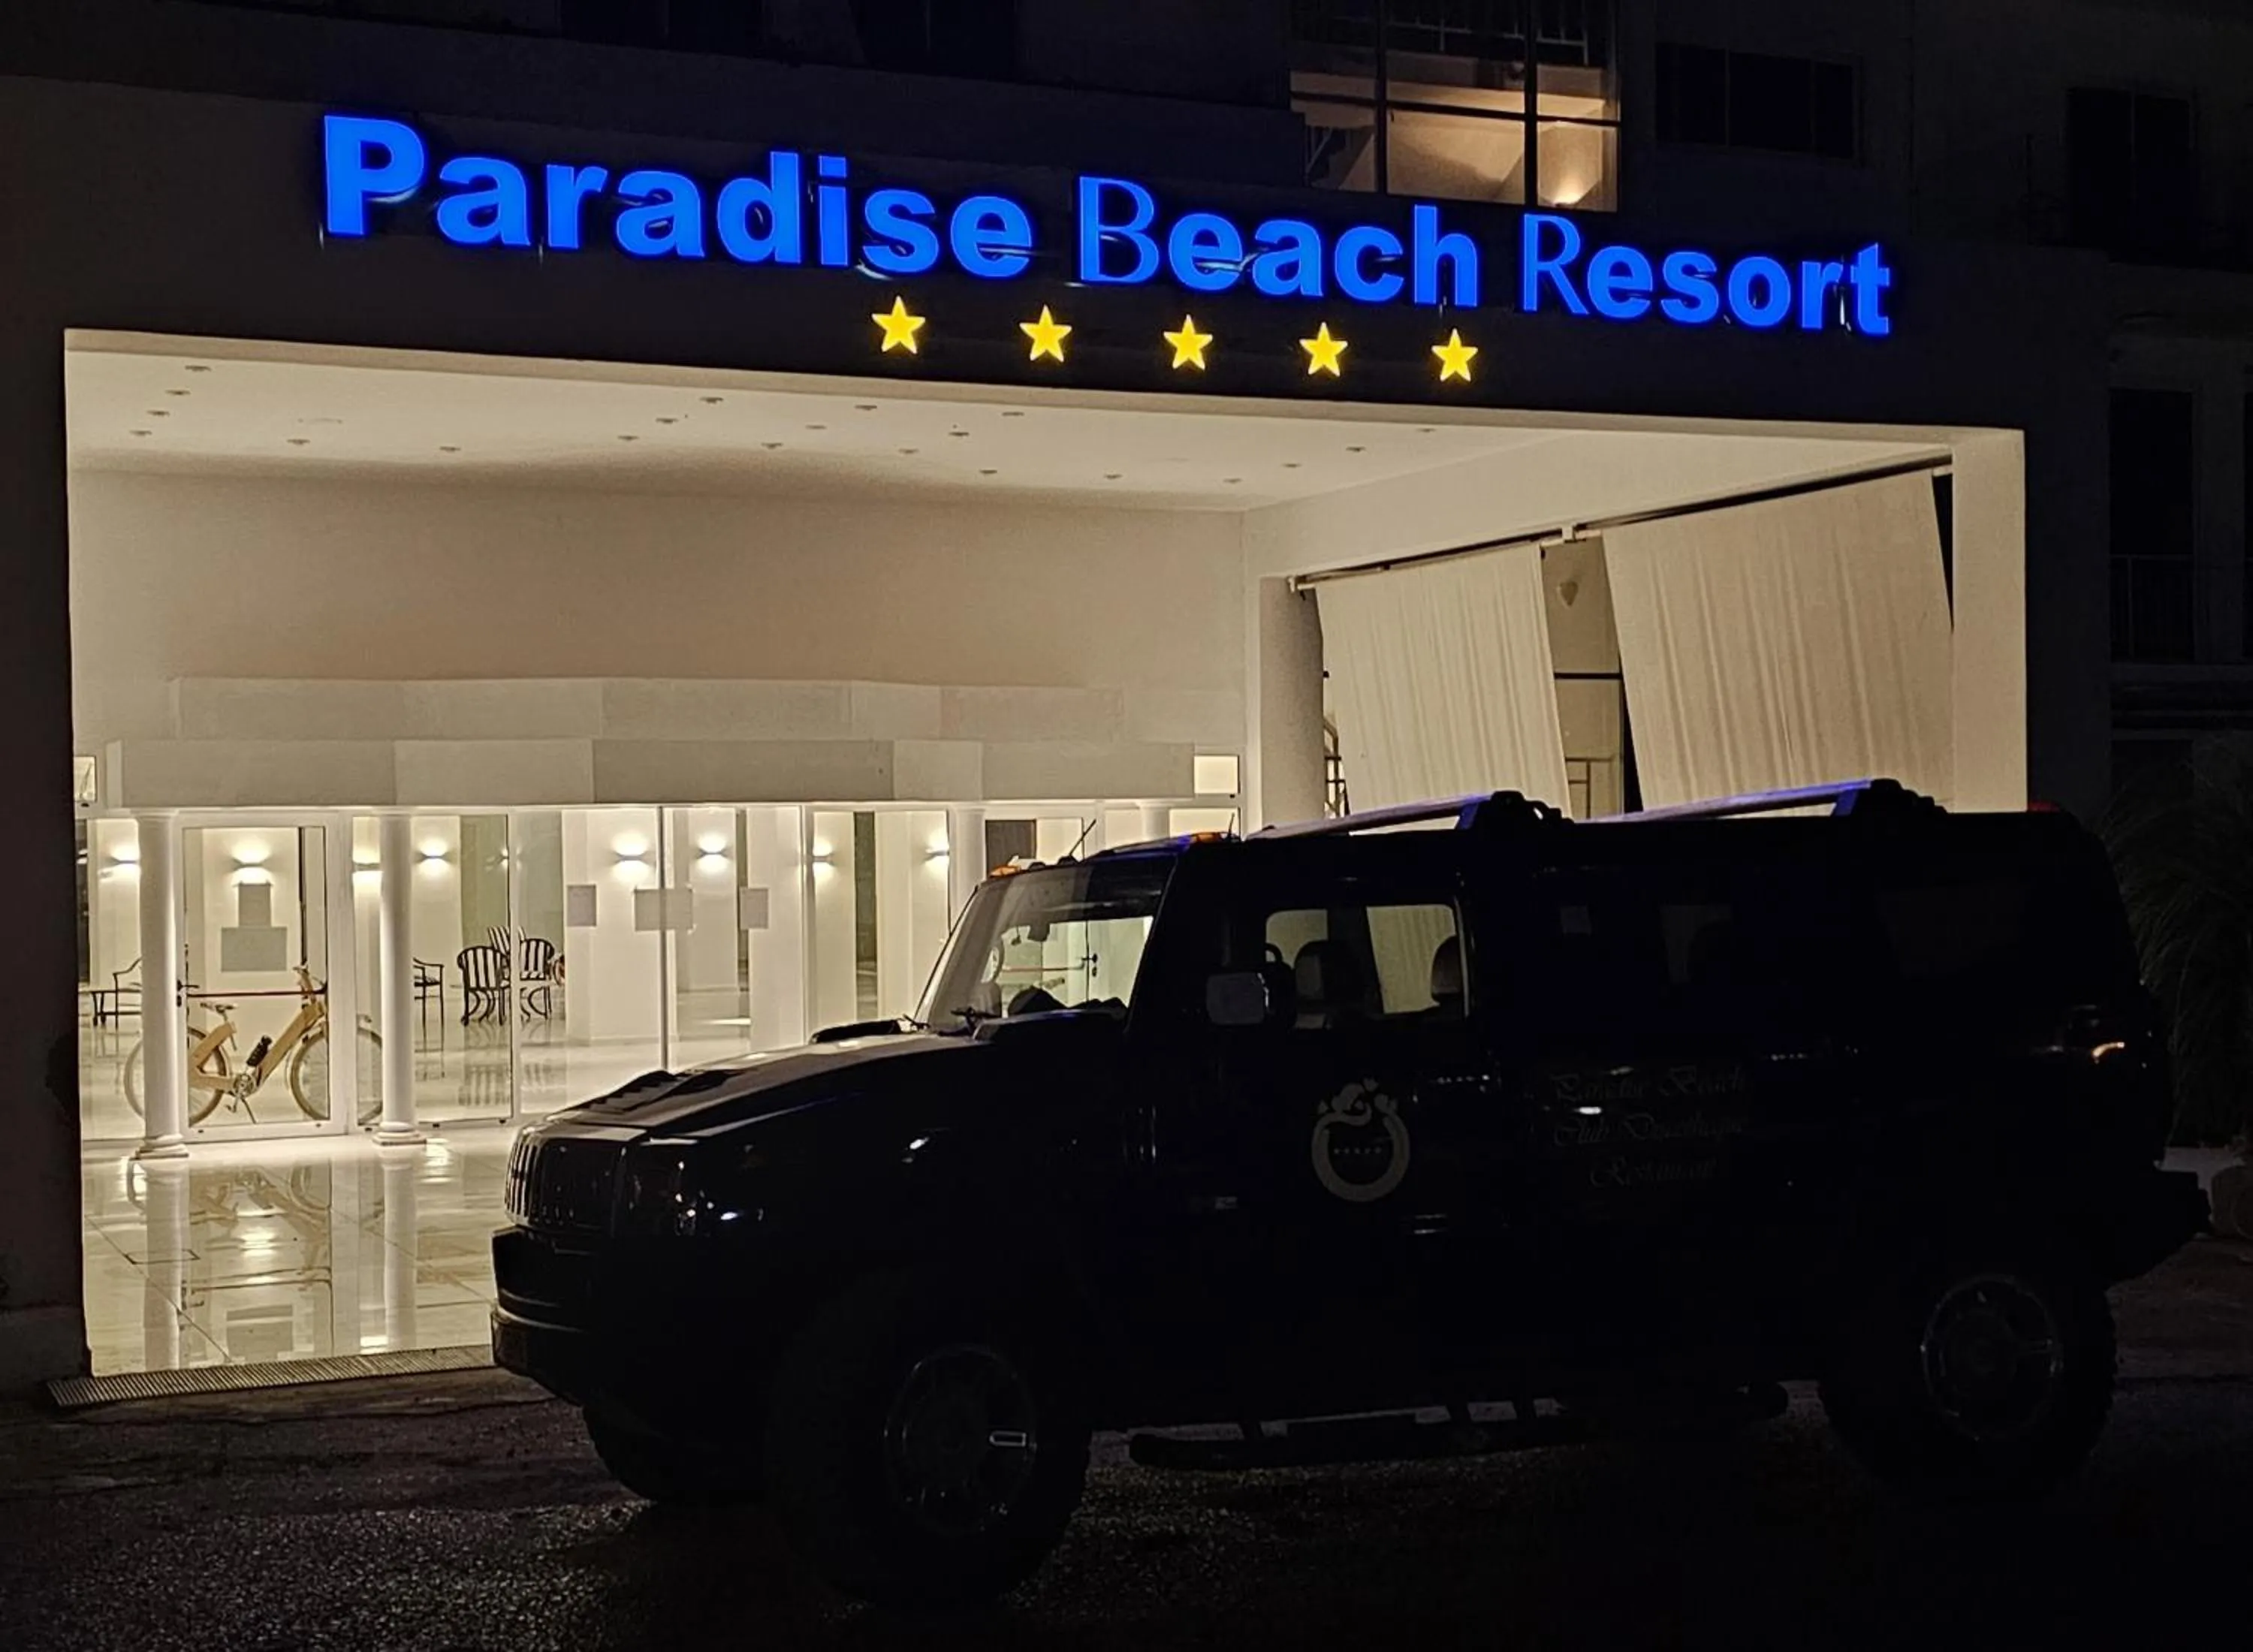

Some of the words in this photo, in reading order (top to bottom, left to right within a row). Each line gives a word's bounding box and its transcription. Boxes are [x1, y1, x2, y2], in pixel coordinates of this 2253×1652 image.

[323, 113, 1034, 279] Paradise
[1078, 175, 1479, 309] Beach
[1522, 213, 1892, 337] Resort
